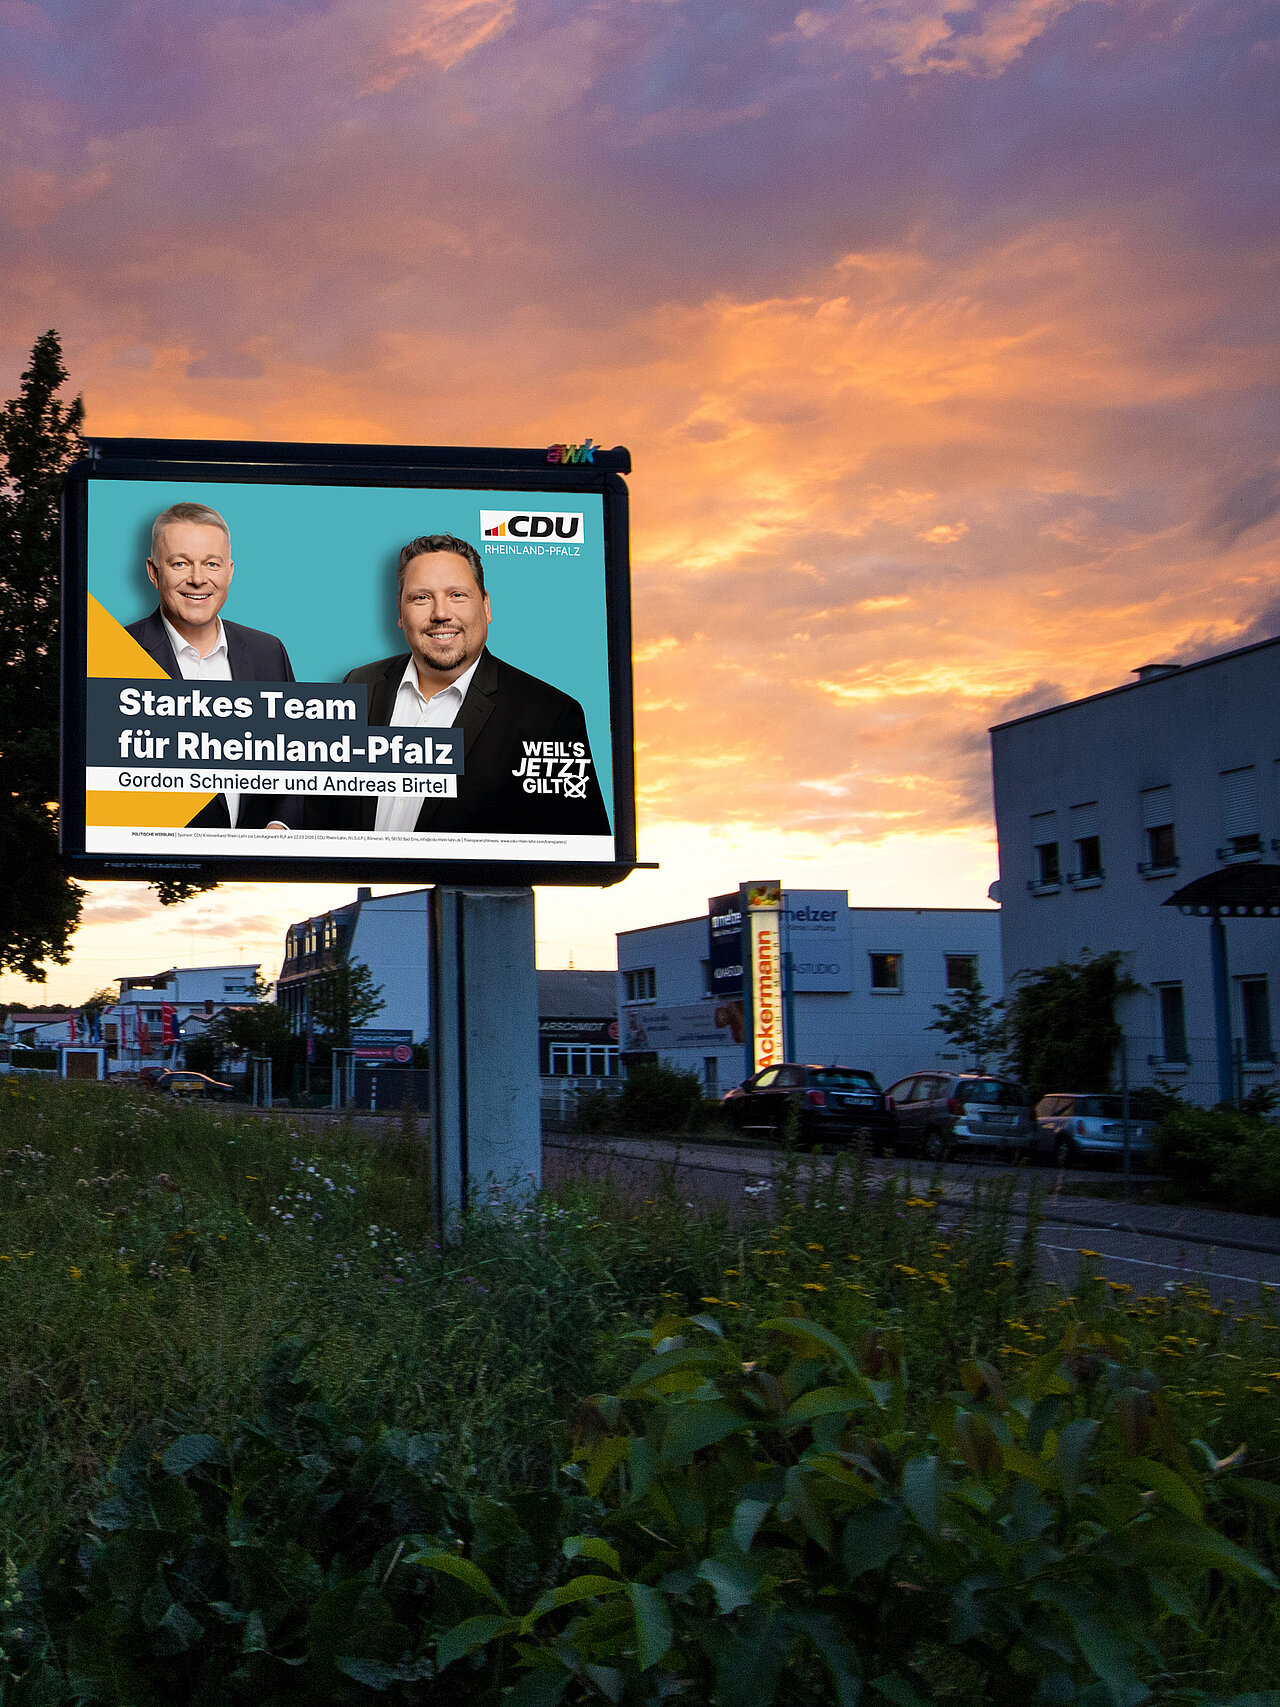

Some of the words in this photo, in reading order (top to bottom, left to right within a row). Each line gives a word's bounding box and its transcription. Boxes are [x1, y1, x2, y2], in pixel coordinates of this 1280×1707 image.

[546, 438, 601, 464] awk
[507, 515, 579, 538] CDU
[484, 544, 581, 556] RHEINLAND-PFALZ
[119, 687, 253, 718] Starkes
[260, 691, 357, 720] Team
[118, 729, 170, 759] für
[177, 731, 454, 765] Rheinland-Pfalz
[511, 757, 592, 778] JETZT
[118, 771, 184, 788] Gordon
[190, 773, 279, 790] Schnieder
[285, 776, 318, 791] und
[323, 776, 396, 793] Andreas
[402, 777, 448, 794] Birtel
[522, 778, 564, 794] GILT
[757, 930, 775, 1068] Ackermann
